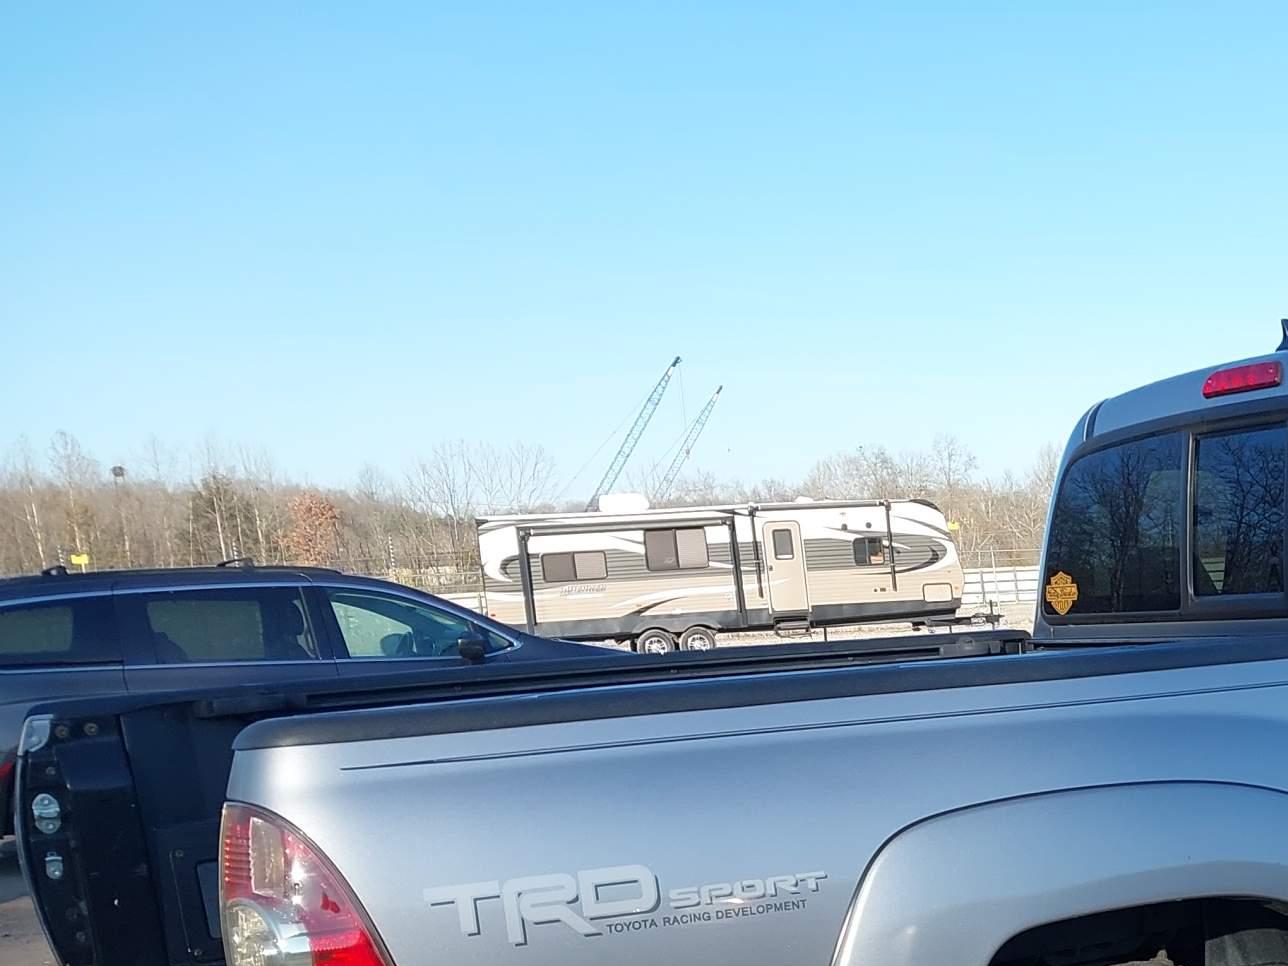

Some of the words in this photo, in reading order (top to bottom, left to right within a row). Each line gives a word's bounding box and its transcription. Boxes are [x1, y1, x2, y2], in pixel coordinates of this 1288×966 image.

[423, 865, 661, 946] TRD
[669, 870, 828, 909] SPORT
[606, 919, 658, 934] TOYOTA
[663, 911, 711, 926] RACING
[716, 899, 808, 920] DEVELOPMENT
